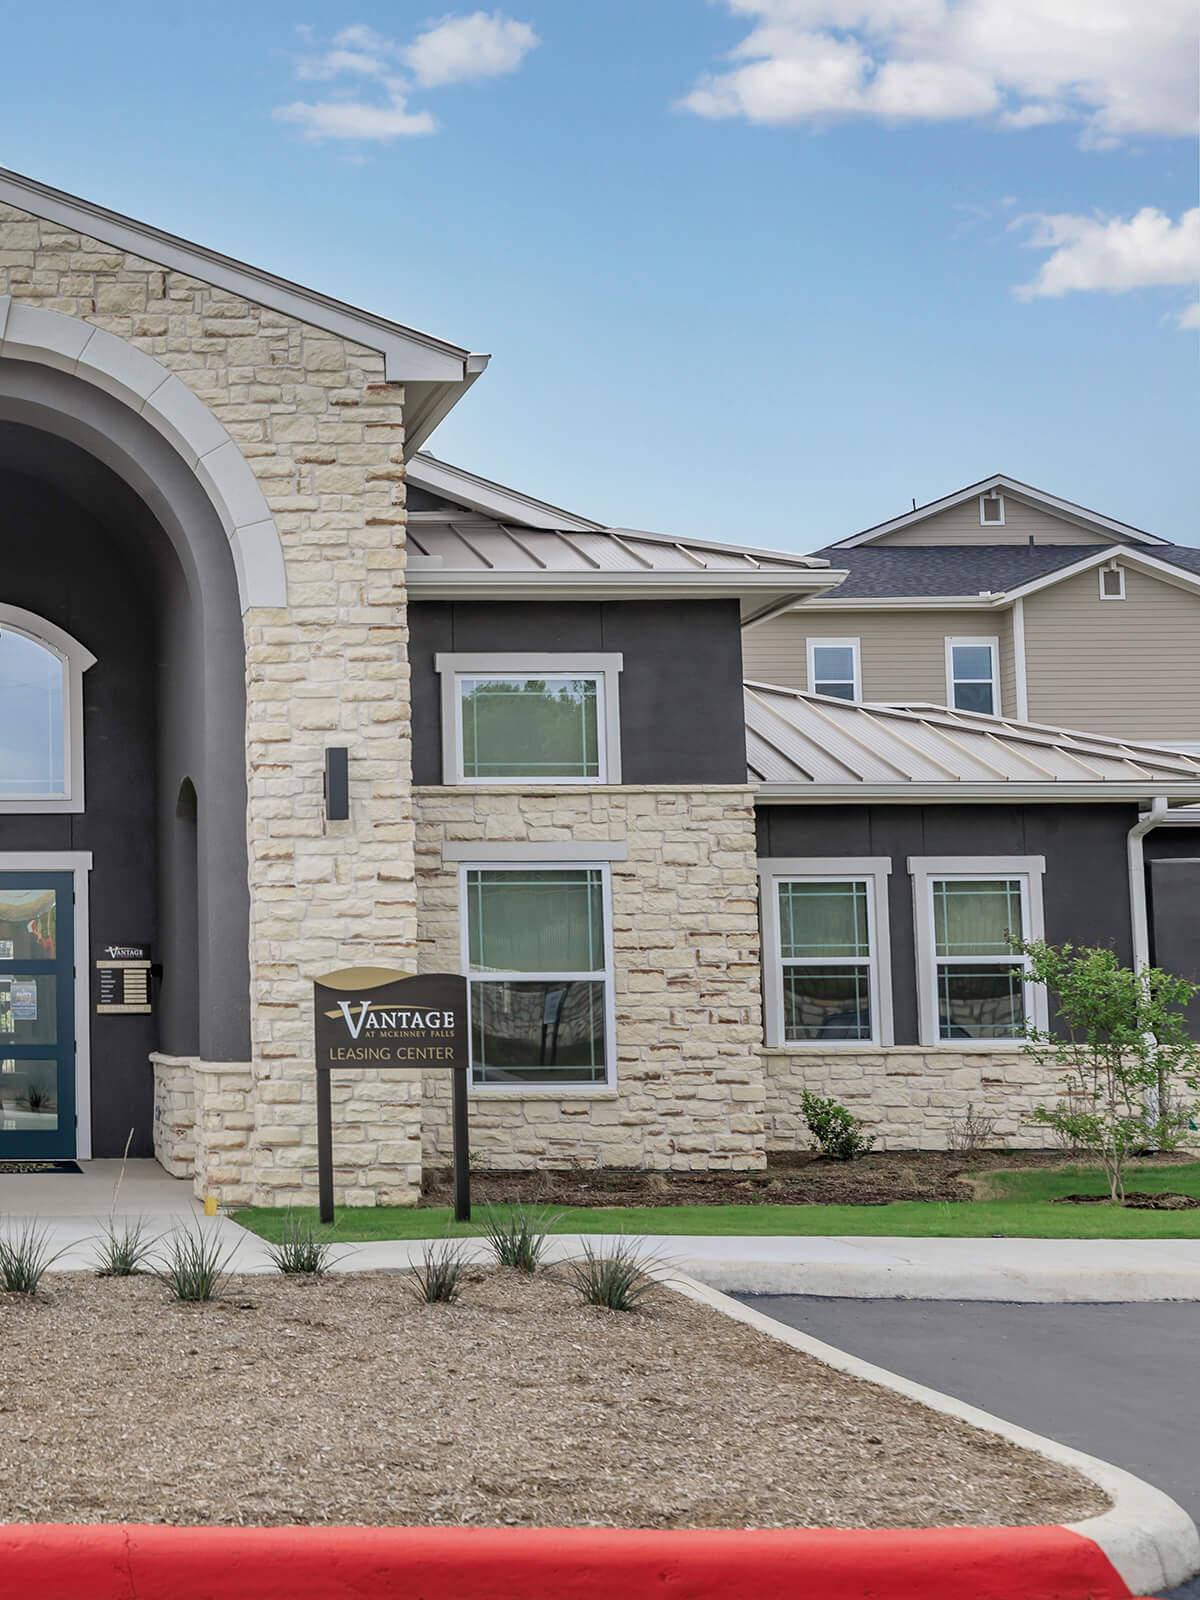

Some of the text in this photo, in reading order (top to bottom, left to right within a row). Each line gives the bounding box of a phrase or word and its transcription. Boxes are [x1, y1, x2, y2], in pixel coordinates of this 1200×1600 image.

[108, 946, 143, 959] VANTAGE
[337, 1000, 455, 1039] VANTAGE
[365, 1030, 375, 1038] AT
[380, 1030, 426, 1038] MCKINNEY
[329, 1047, 454, 1061] LEASING CENTER
